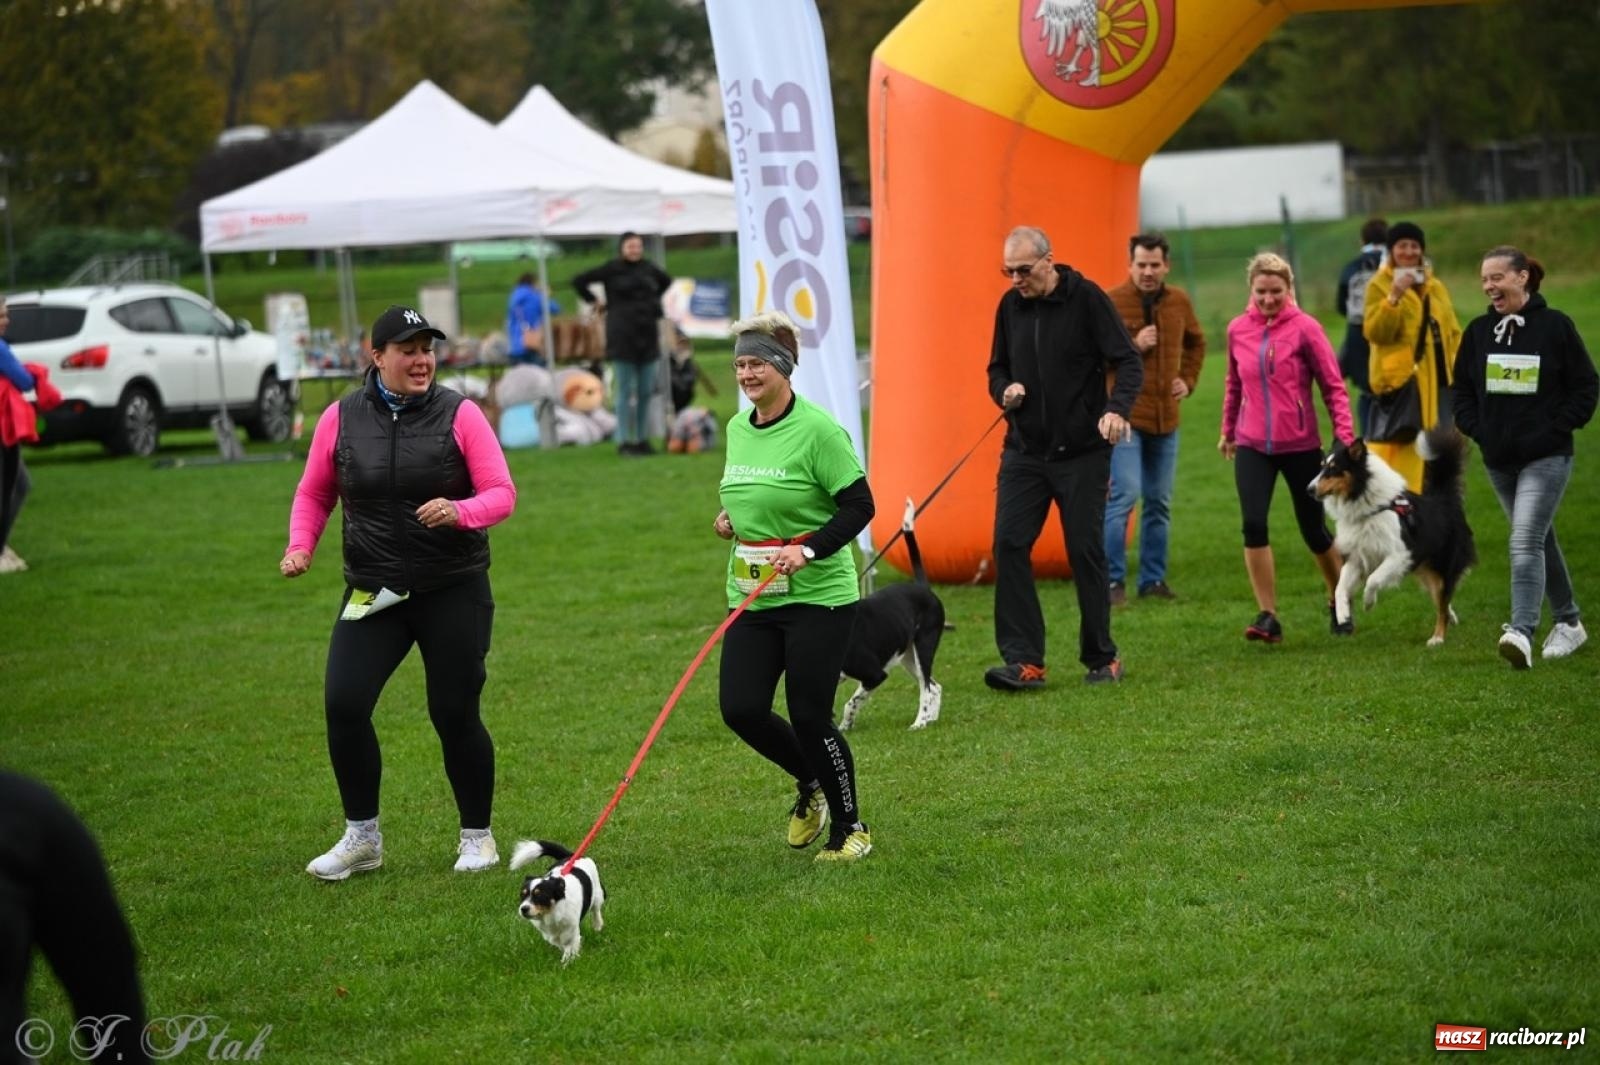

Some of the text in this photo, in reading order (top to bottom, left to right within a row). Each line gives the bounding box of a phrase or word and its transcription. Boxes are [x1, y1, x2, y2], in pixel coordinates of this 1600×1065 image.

[1503, 367, 1521, 380] 21
[750, 564, 761, 579] 6
[823, 737, 853, 813] OCEANS APART
